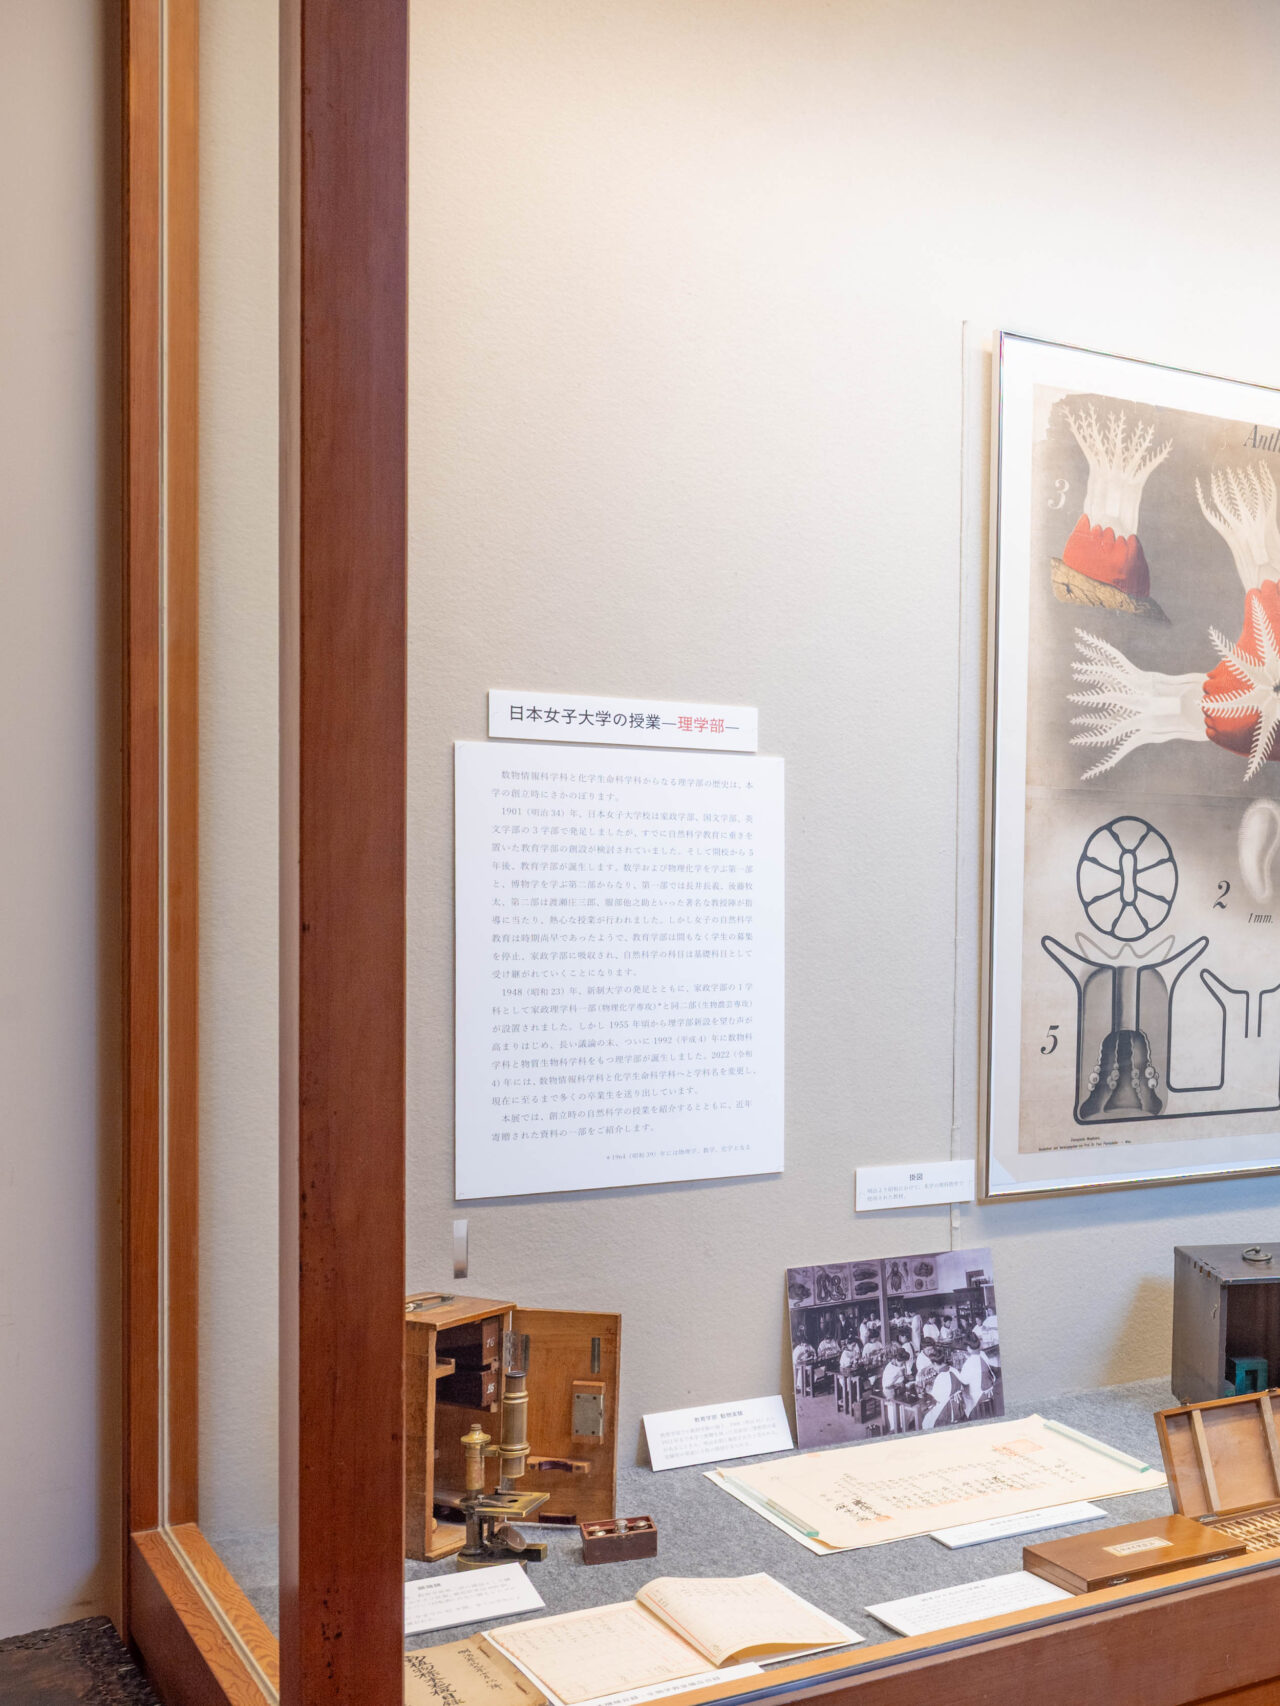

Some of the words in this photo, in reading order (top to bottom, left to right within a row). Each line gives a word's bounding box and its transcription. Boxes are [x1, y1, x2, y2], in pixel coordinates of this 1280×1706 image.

[1047, 478, 1070, 510] 3
[1212, 879, 1232, 911] 2
[1041, 1024, 1060, 1056] 5
